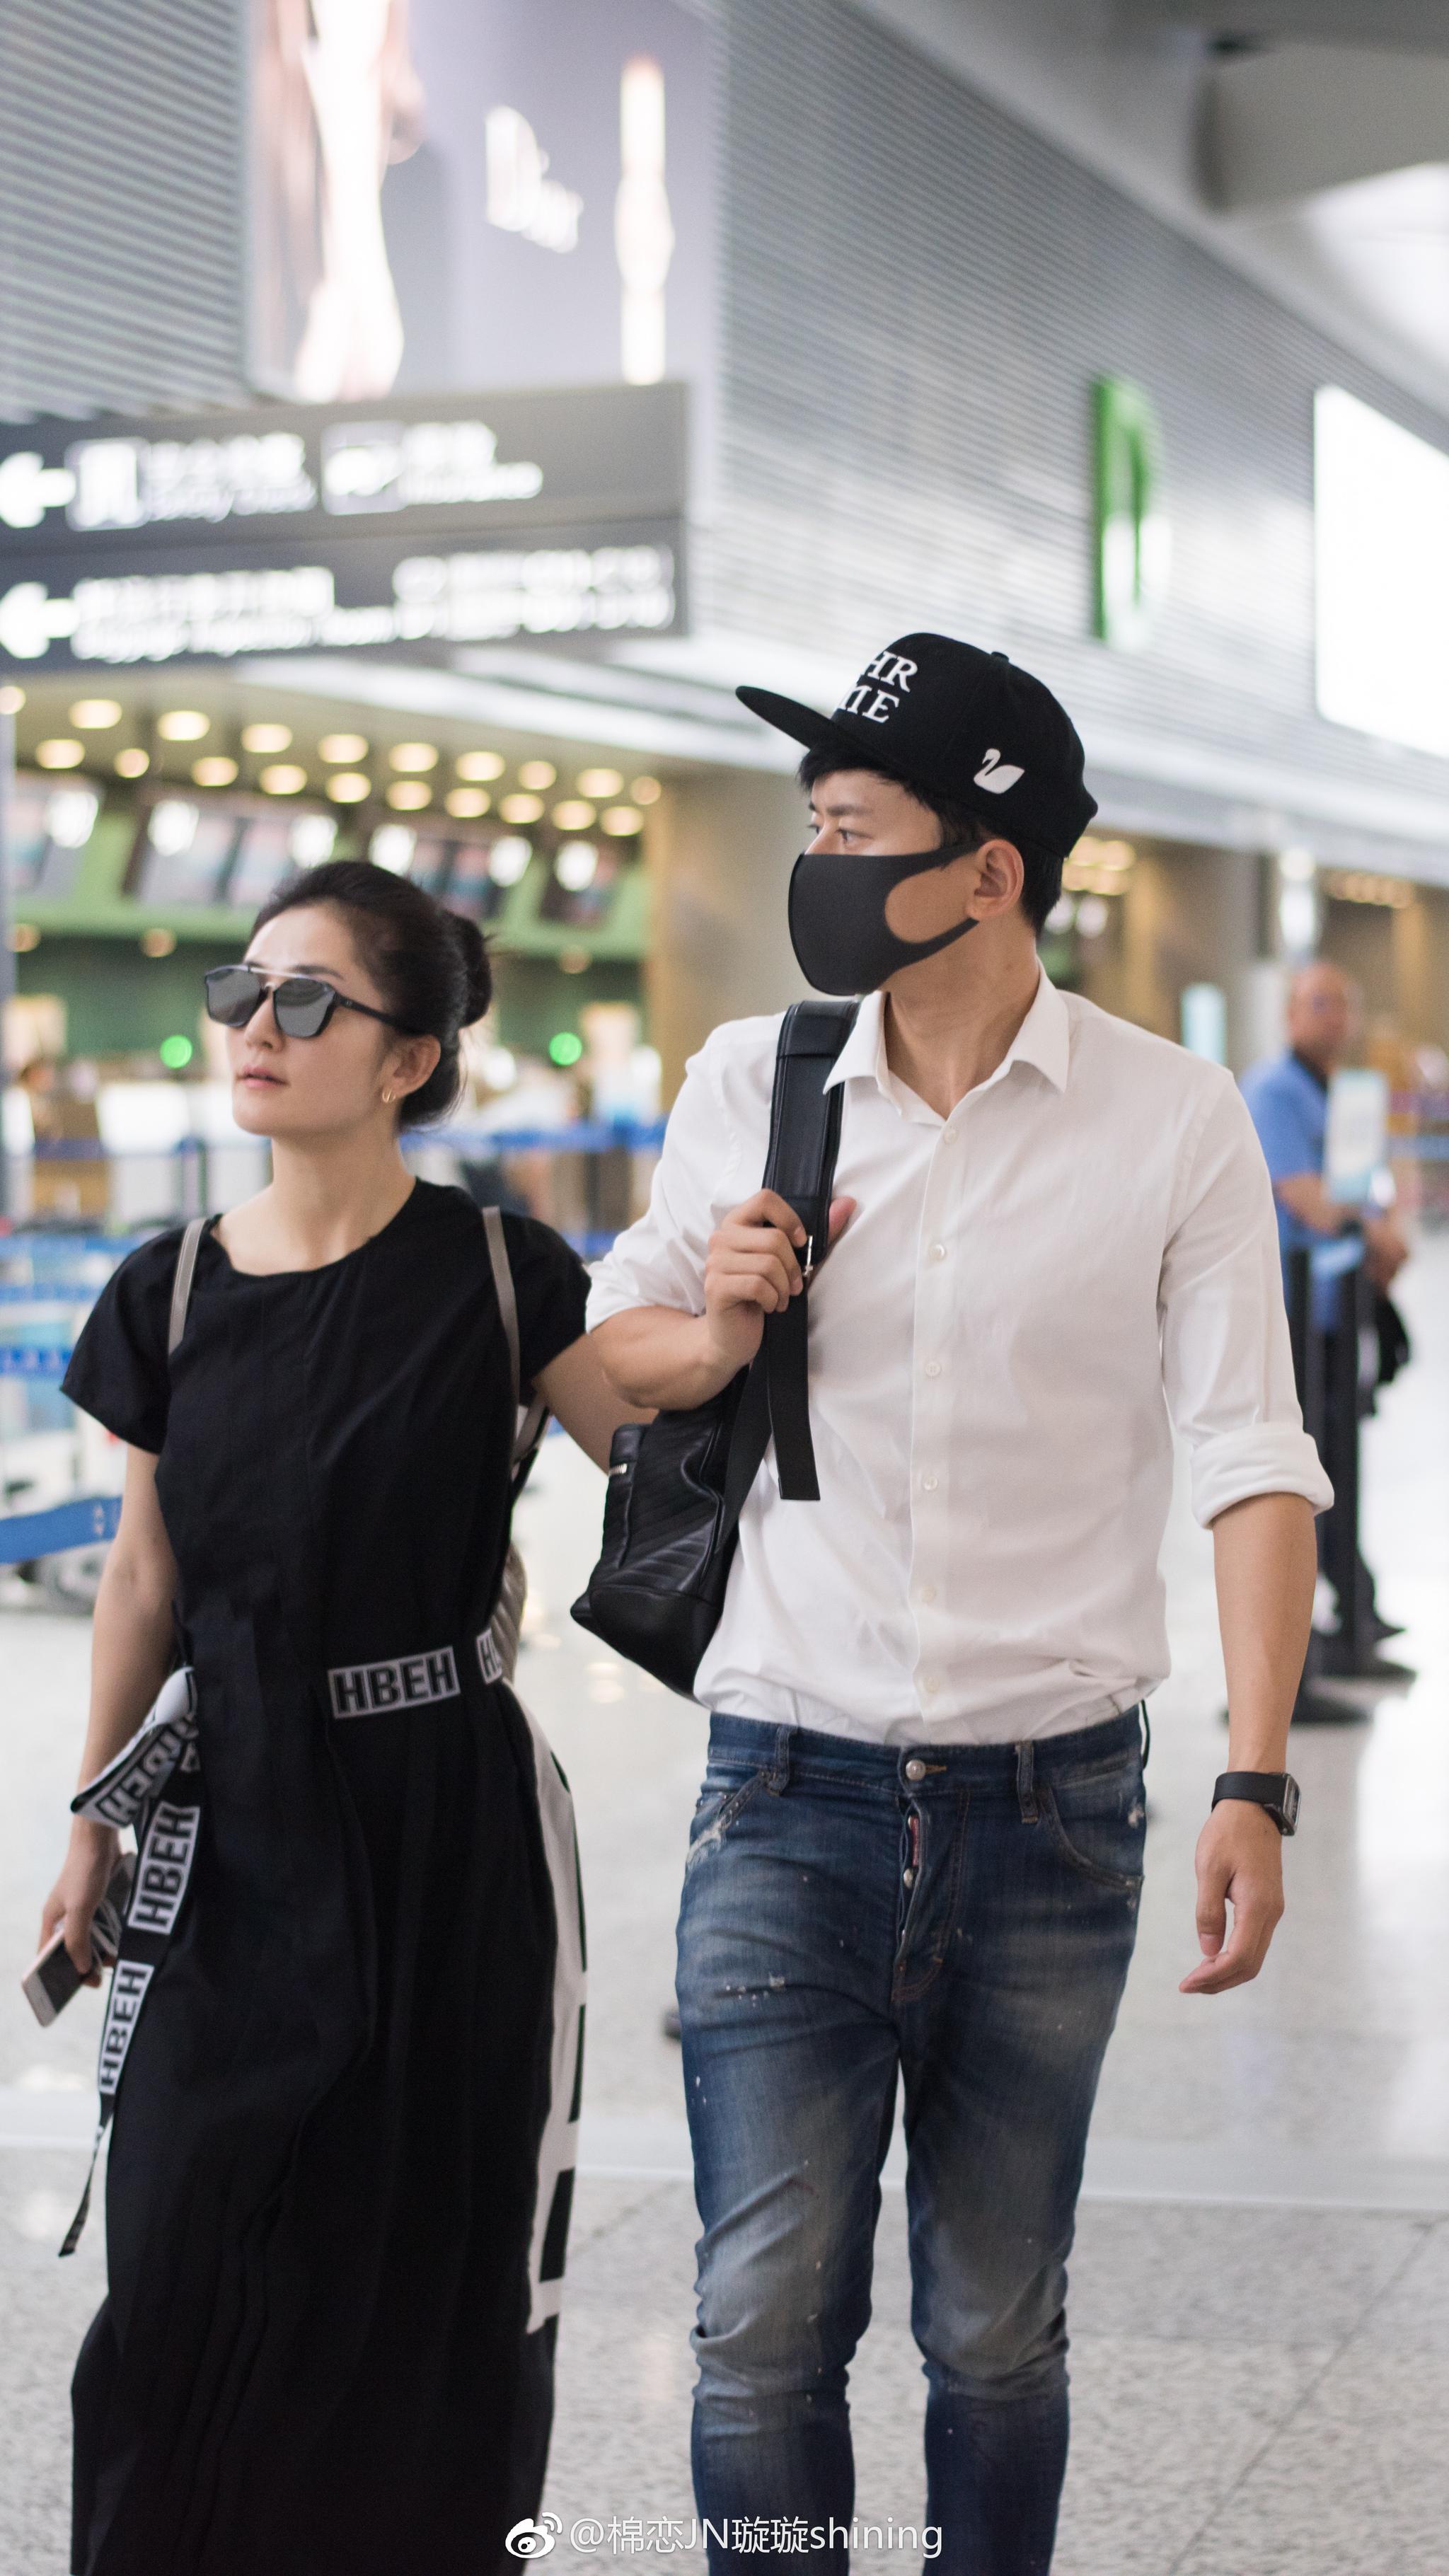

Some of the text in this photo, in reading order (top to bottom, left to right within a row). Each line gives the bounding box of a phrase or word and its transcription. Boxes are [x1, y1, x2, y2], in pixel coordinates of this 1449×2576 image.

[333, 1651, 456, 1712] HBEH
[135, 1808, 195, 1927] HBEH
[100, 1967, 148, 2086] HBEH
